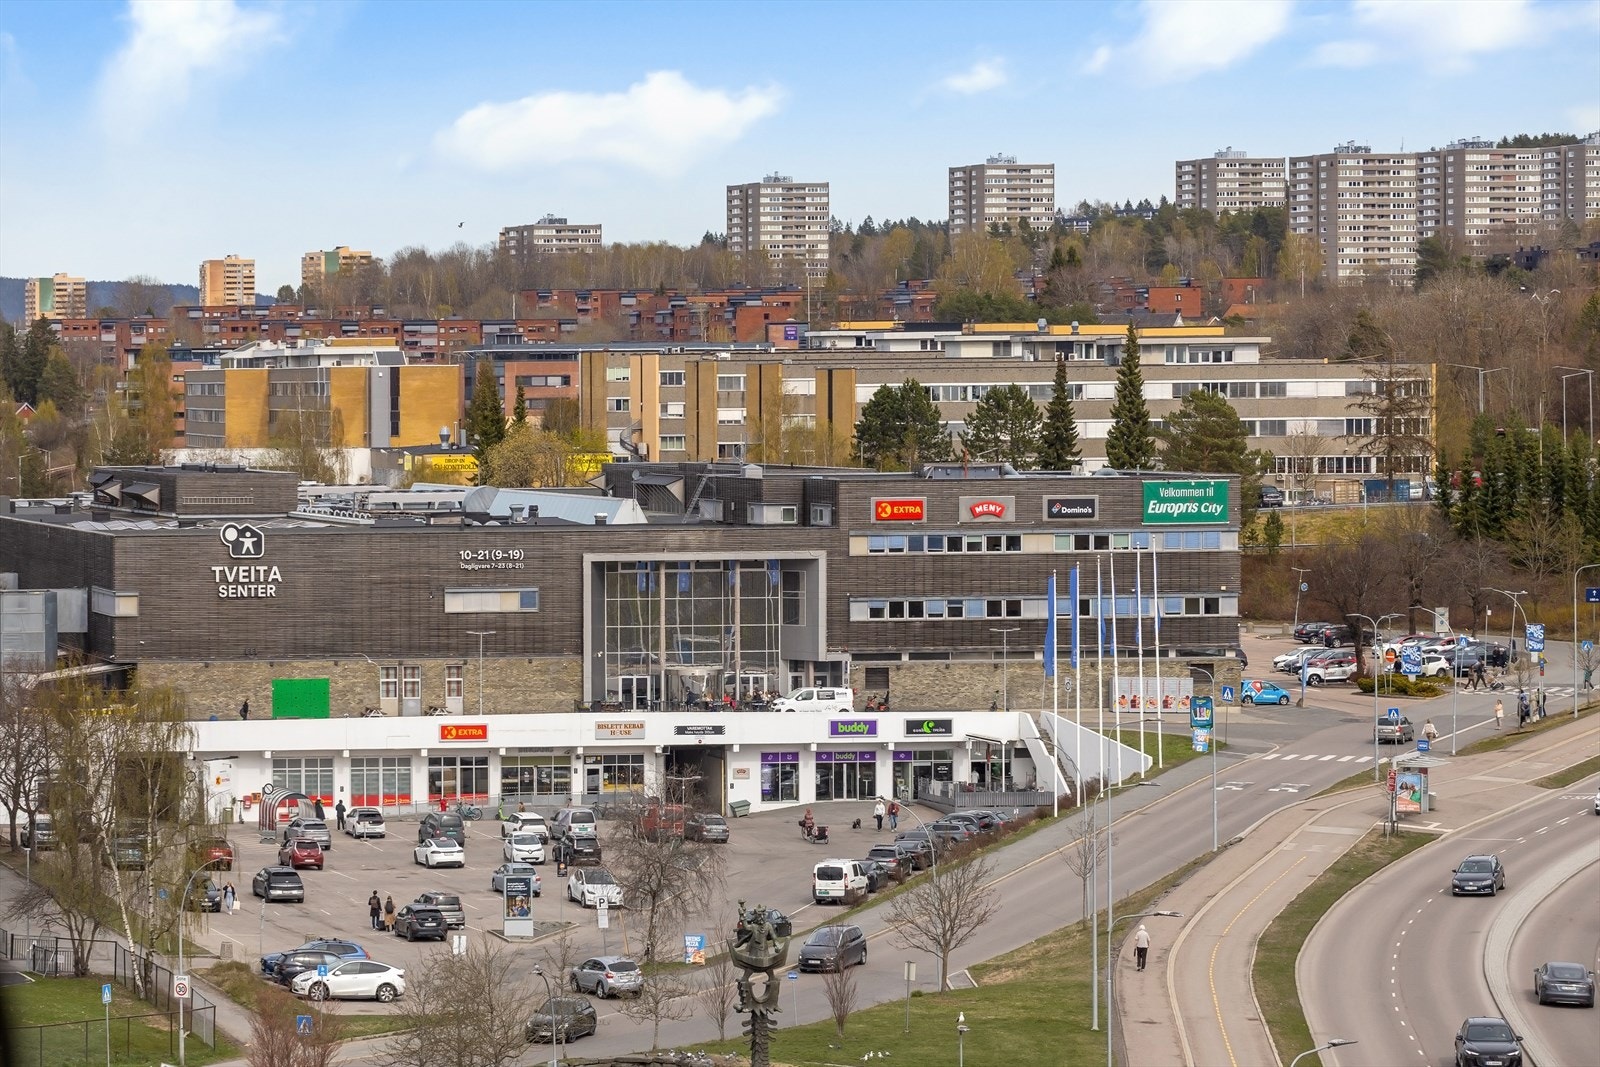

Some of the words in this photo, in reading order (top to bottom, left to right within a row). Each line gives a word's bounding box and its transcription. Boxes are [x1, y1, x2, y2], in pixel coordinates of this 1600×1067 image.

[1159, 487, 1204, 497] Velkommen
[1206, 487, 1214, 496] til
[893, 505, 922, 514] EXTRA
[974, 503, 1002, 513] MENY
[1061, 505, 1092, 514] Domino's
[1147, 500, 1199, 517] Europris
[1200, 502, 1223, 515] City
[460, 562, 490, 570] Dagligvare
[211, 566, 283, 582] TVEITA
[219, 584, 276, 597] SENTER
[838, 722, 869, 735] buddy
[835, 752, 855, 760] buddy
[598, 898, 605, 907] P
[177, 985, 185, 993] 30
